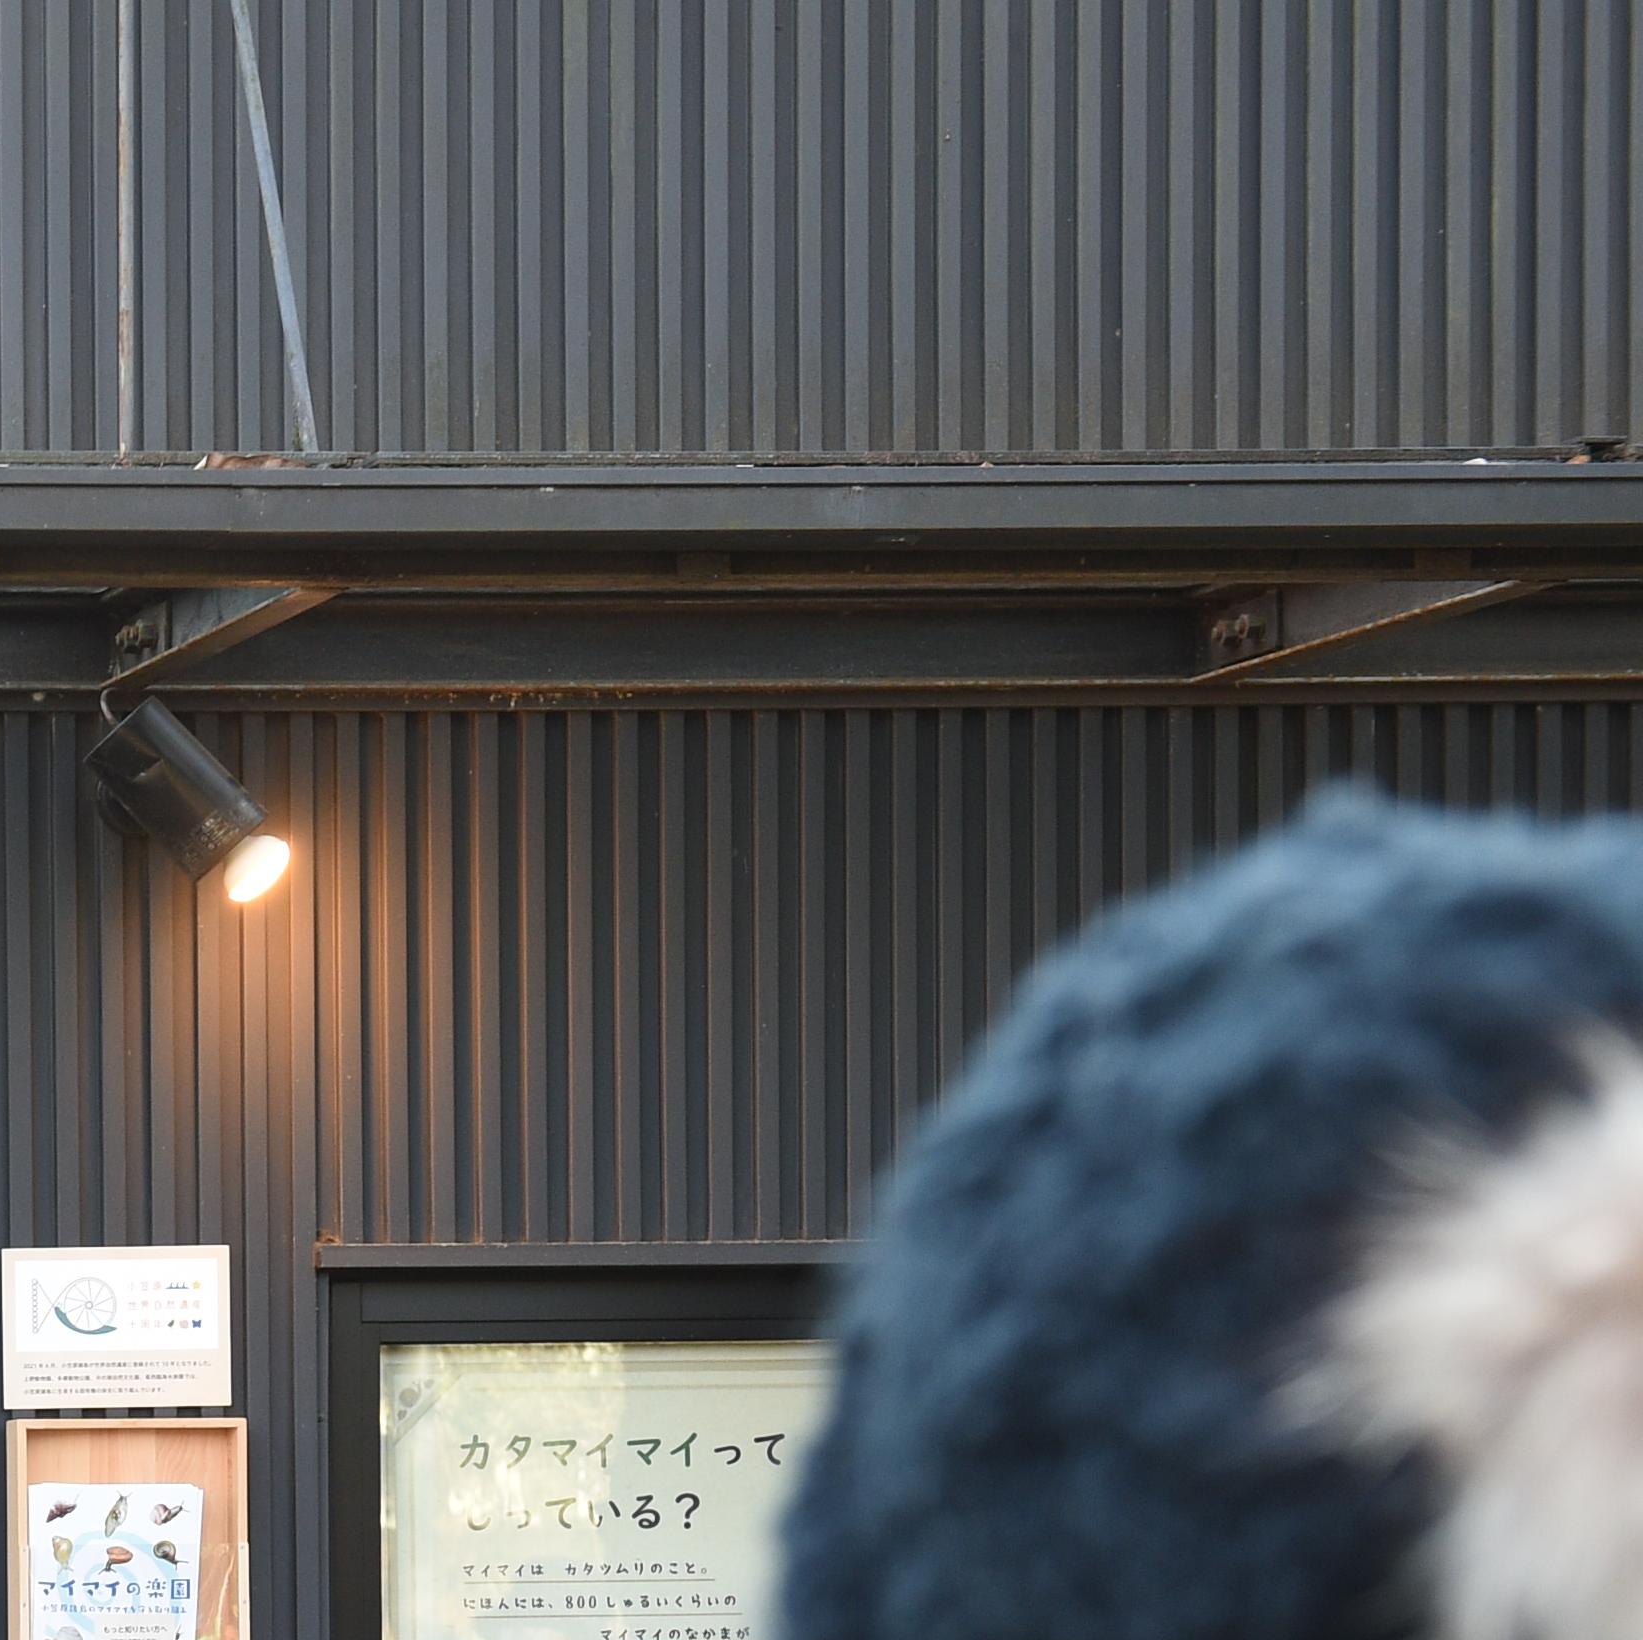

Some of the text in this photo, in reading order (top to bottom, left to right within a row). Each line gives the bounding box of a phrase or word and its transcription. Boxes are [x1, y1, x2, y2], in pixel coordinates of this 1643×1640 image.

[460, 1432, 785, 1469] カタマイマイって
[463, 1562, 708, 1577] マイマイは カタツムリのこと。
[38, 1578, 190, 1599] マイマイの楽園
[103, 1625, 168, 1634] もっと知りたい方へ
